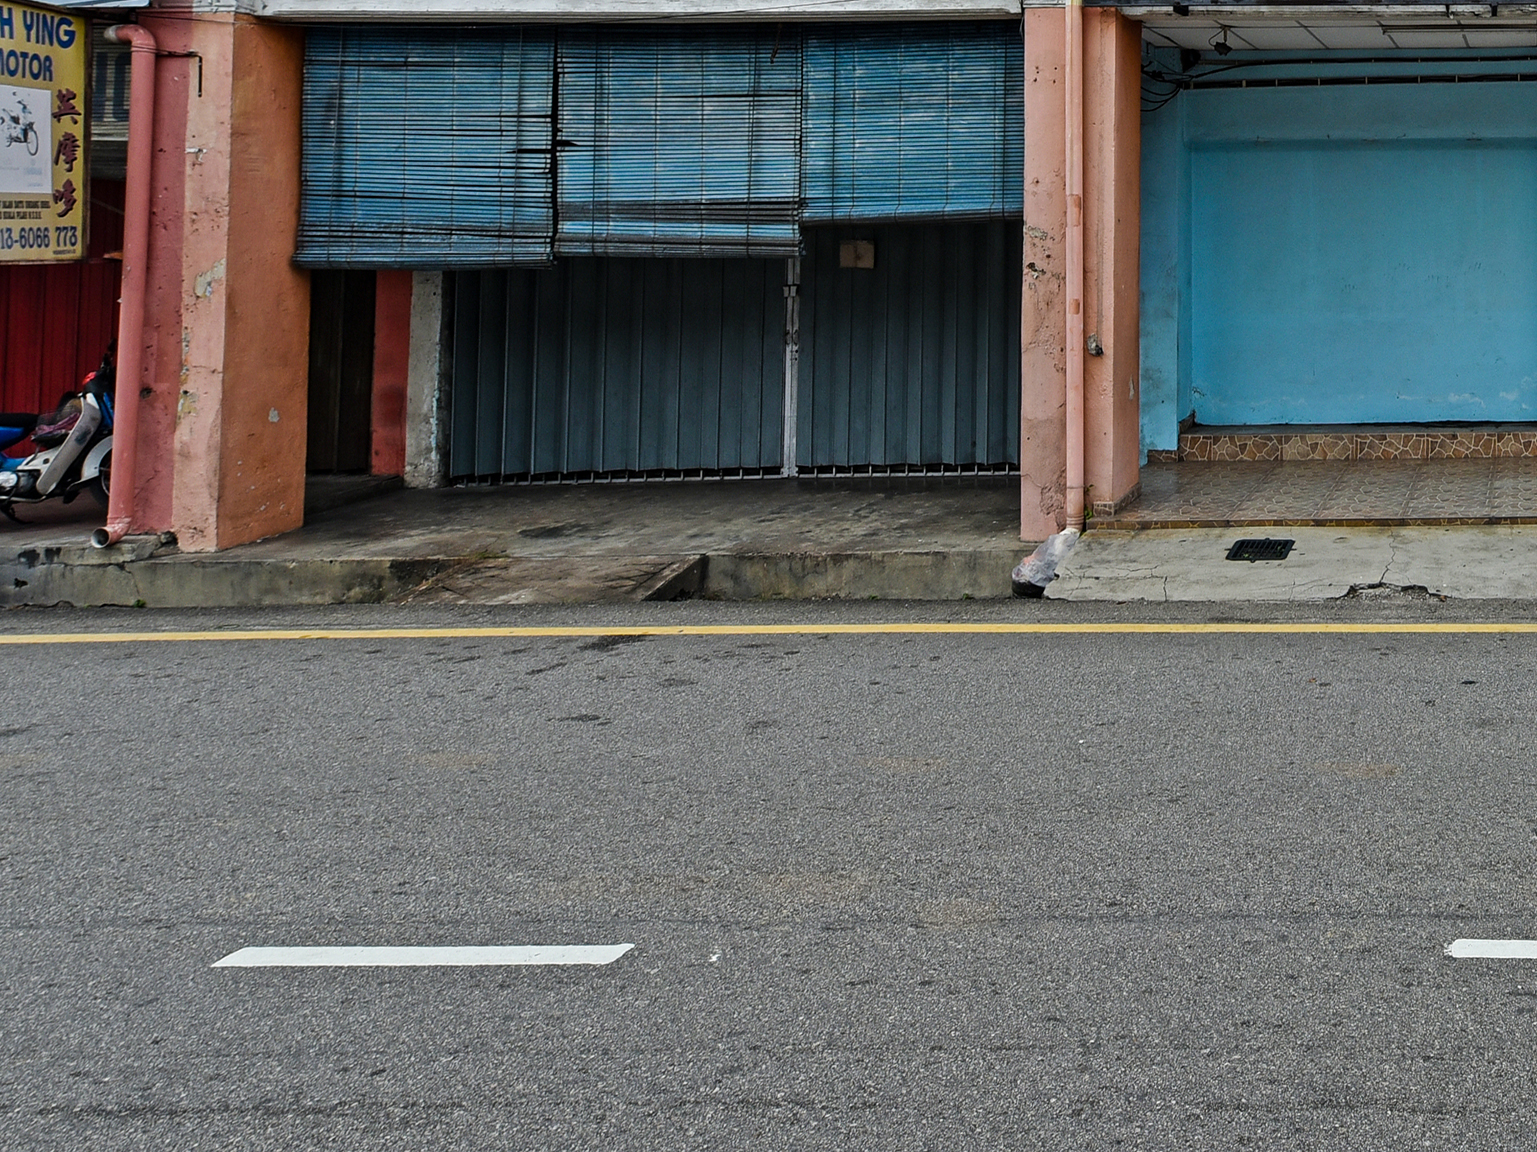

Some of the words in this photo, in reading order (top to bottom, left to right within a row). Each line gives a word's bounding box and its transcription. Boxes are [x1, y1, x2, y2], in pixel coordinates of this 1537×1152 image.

[22, 10, 76, 49] YING
[0, 49, 53, 83] OTOR
[55, 226, 78, 248] 773
